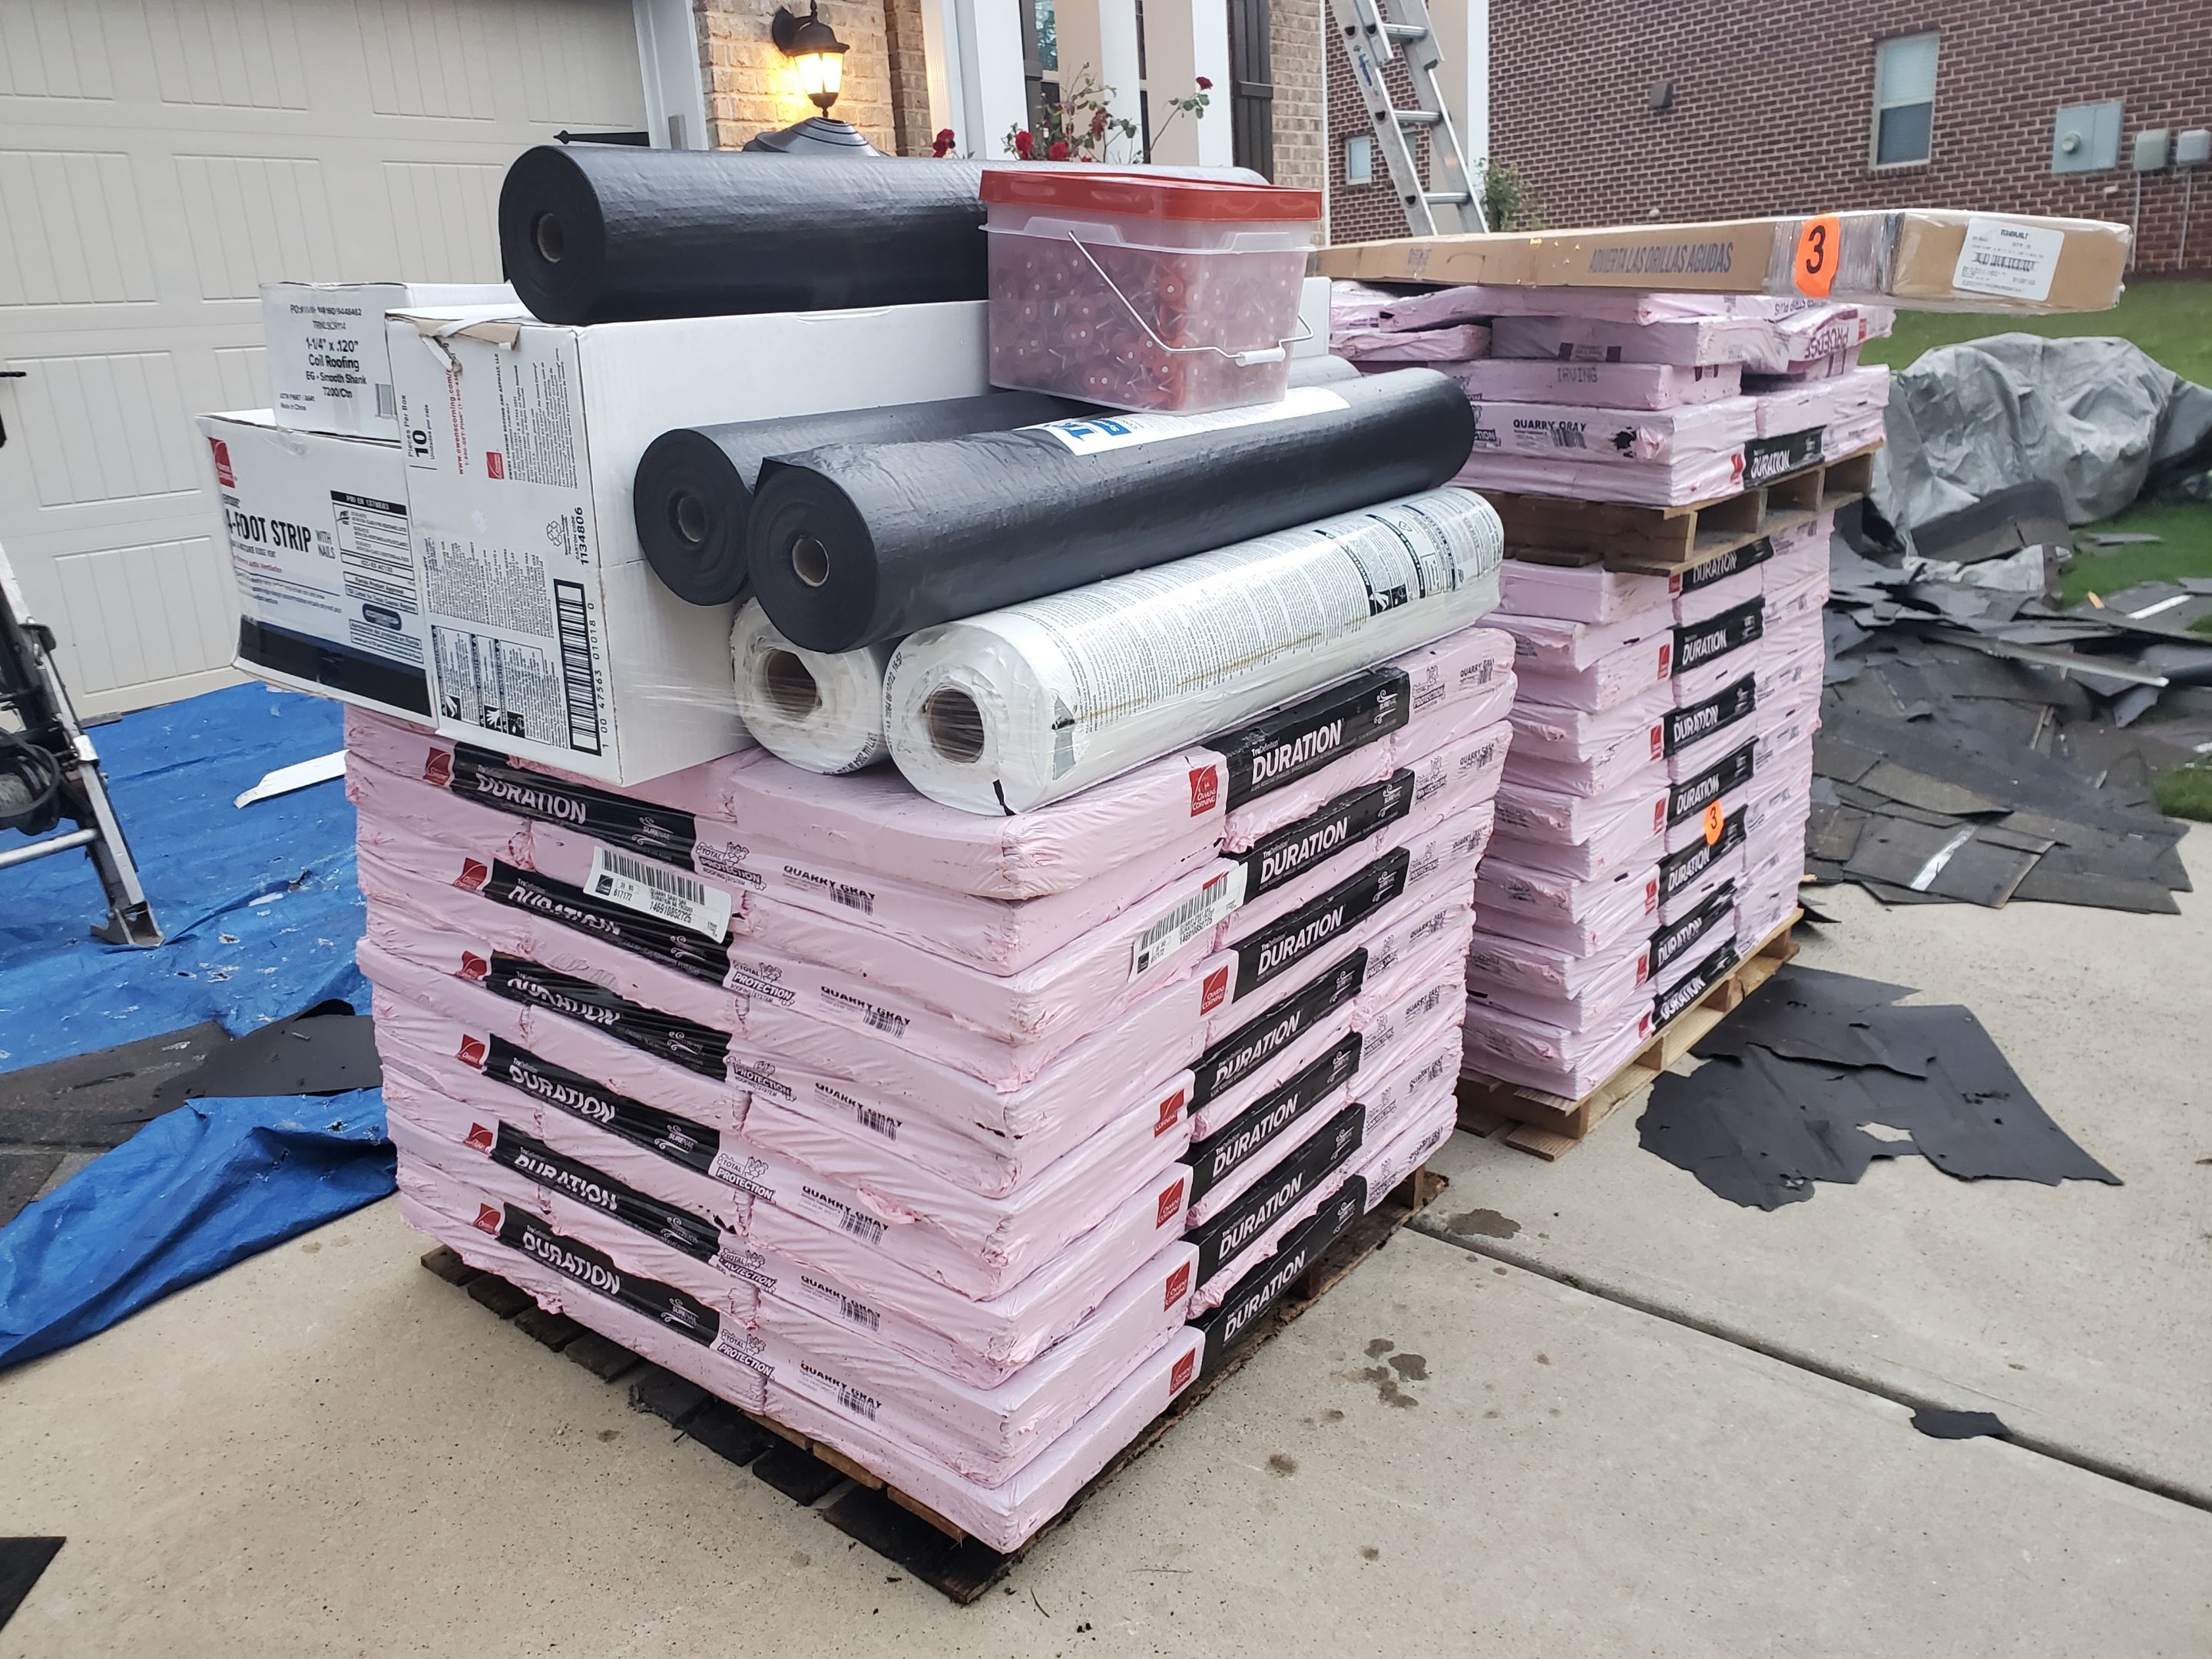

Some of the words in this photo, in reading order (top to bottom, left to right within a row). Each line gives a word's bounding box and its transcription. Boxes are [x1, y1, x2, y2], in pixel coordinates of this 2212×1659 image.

[1626, 247, 1645, 274] LAS
[1644, 244, 1687, 274] ORILLAS
[1687, 242, 1734, 273] AGUDAS
[1806, 224, 1826, 273] 3
[329, 343, 335, 351] x
[309, 353, 324, 367] Coil
[326, 356, 360, 373] Roofing
[1557, 367, 1598, 382] IRVING
[306, 371, 316, 381] EG
[320, 372, 346, 384] Smooth
[346, 373, 368, 386] Shank
[399, 395, 408, 410] Box
[1513, 419, 1555, 430] QUARRY
[1559, 421, 1587, 432] GRAY
[405, 429, 413, 457] Pieces
[412, 429, 429, 458] 10
[427, 430, 435, 459] Unidades
[1750, 449, 1790, 479] DURATION
[270, 519, 312, 553] STRIP
[315, 530, 332, 545] WITH
[575, 506, 589, 566] 1134806
[316, 544, 336, 559] NAILS
[1693, 551, 1737, 583] DURATION
[588, 602, 594, 611] 0
[589, 619, 600, 661] 01018
[1682, 628, 1727, 666] DURATION
[1459, 664, 1482, 677] QUARRY
[594, 669, 606, 710] 47563
[600, 718, 608, 733] 00
[1674, 704, 1719, 743] DURATION
[1250, 737, 1280, 757] TruDefinition
[1251, 719, 1343, 786] DURATION
[1459, 750, 1482, 766] QUARRY
[475, 773, 587, 825] DURATION
[1192, 796, 1216, 811] CORNING
[1197, 787, 1217, 803] OWENS
[1676, 773, 1720, 816] DURATION
[1709, 806, 1717, 830] 3
[700, 847, 722, 861] TOTAL
[1260, 816, 1349, 885] DURATION
[700, 857, 762, 884] PROTECTION
[703, 866, 726, 880] ROOFING
[783, 865, 835, 888] QUARRY
[839, 882, 876, 901] GRAY
[1667, 846, 1710, 892] DURATION
[613, 889, 632, 902] 617172
[649, 901, 692, 922] 146910852725
[1257, 905, 1344, 975] DURATION
[1657, 917, 1703, 968] DURATION
[740, 964, 760, 977] TOTAL
[732, 972, 796, 1002] PROTECTION
[1201, 992, 1225, 1011] CORNING
[1206, 985, 1226, 1002] OWENS
[820, 985, 873, 1011] QUARRY
[876, 1006, 911, 1026] GRAY
[1212, 1009, 1302, 1091] DURATION
[509, 1064, 615, 1123] DURATION
[733, 1063, 793, 1097] PROTECTION
[815, 1081, 863, 1110] QUARRY
[1212, 1093, 1300, 1177] DURATION
[723, 1157, 742, 1173] TOTAL
[514, 1154, 618, 1211] DURATION
[717, 1167, 775, 1199] PROTECTION
[802, 1184, 853, 1214] QUARRY
[854, 1210, 889, 1231] GRAY
[1218, 1172, 1303, 1260] DURATION
[522, 1230, 621, 1295] DURATION
[724, 1253, 745, 1266] TOTAL
[800, 1274, 848, 1301] QUARRY
[1224, 1250, 1306, 1343] DURATION
[724, 1333, 744, 1349] TOTAL
[717, 1342, 774, 1377] PROTECTION
[800, 1362, 847, 1390] QUARRY
[850, 1387, 882, 1409] GRAY
